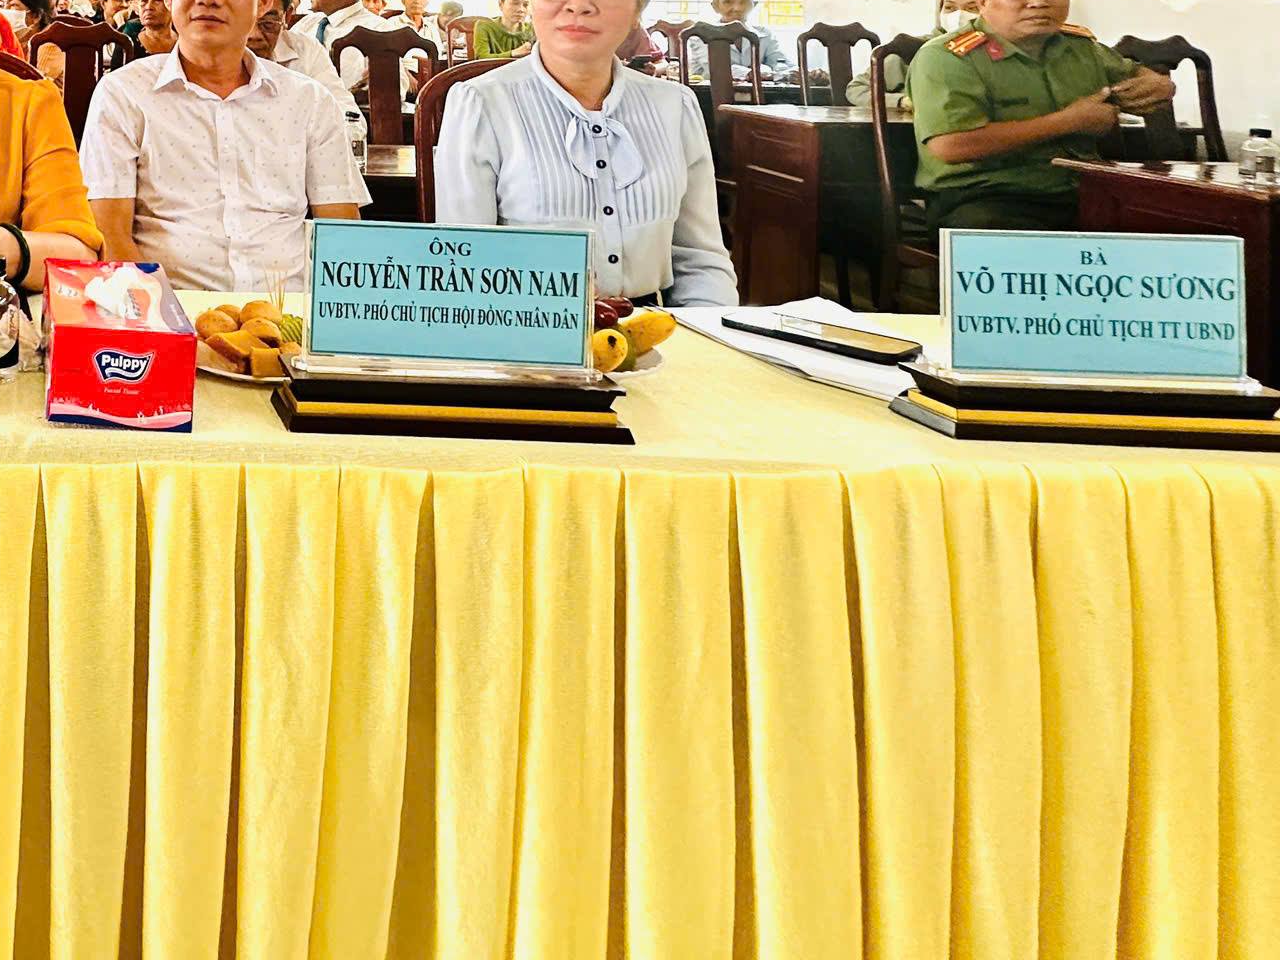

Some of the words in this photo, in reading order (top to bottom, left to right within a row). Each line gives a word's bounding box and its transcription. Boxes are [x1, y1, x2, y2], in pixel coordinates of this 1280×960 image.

[429, 237, 471, 256] ÔNG
[1080, 247, 1108, 266] BÀ
[320, 256, 411, 290] NGUYỄN
[416, 259, 475, 293] TRẦN
[480, 267, 523, 295] SƠN
[528, 270, 579, 298] NAM
[956, 266, 995, 294] VÕ
[1001, 272, 1047, 301] THỊ
[1056, 274, 1132, 303] NGỌC
[1140, 273, 1235, 301] SƯƠNG
[319, 301, 360, 320] UVBTV.
[363, 299, 388, 321] PHÓ
[391, 300, 417, 322] CHỦ
[420, 306, 449, 327] TỊCH
[452, 305, 475, 329] HỘI
[478, 304, 513, 327] ĐỒNG
[515, 306, 550, 328] NHÂN
[552, 308, 579, 329] DÂN
[957, 315, 1020, 334] UVBTV.
[1024, 312, 1061, 335] PHÓ
[1066, 314, 1104, 337] CHỦ
[1108, 319, 1153, 342] TỊCH
[1159, 320, 1181, 339] TT
[1186, 321, 1235, 341] UBND
[101, 354, 148, 371] Pulppy
